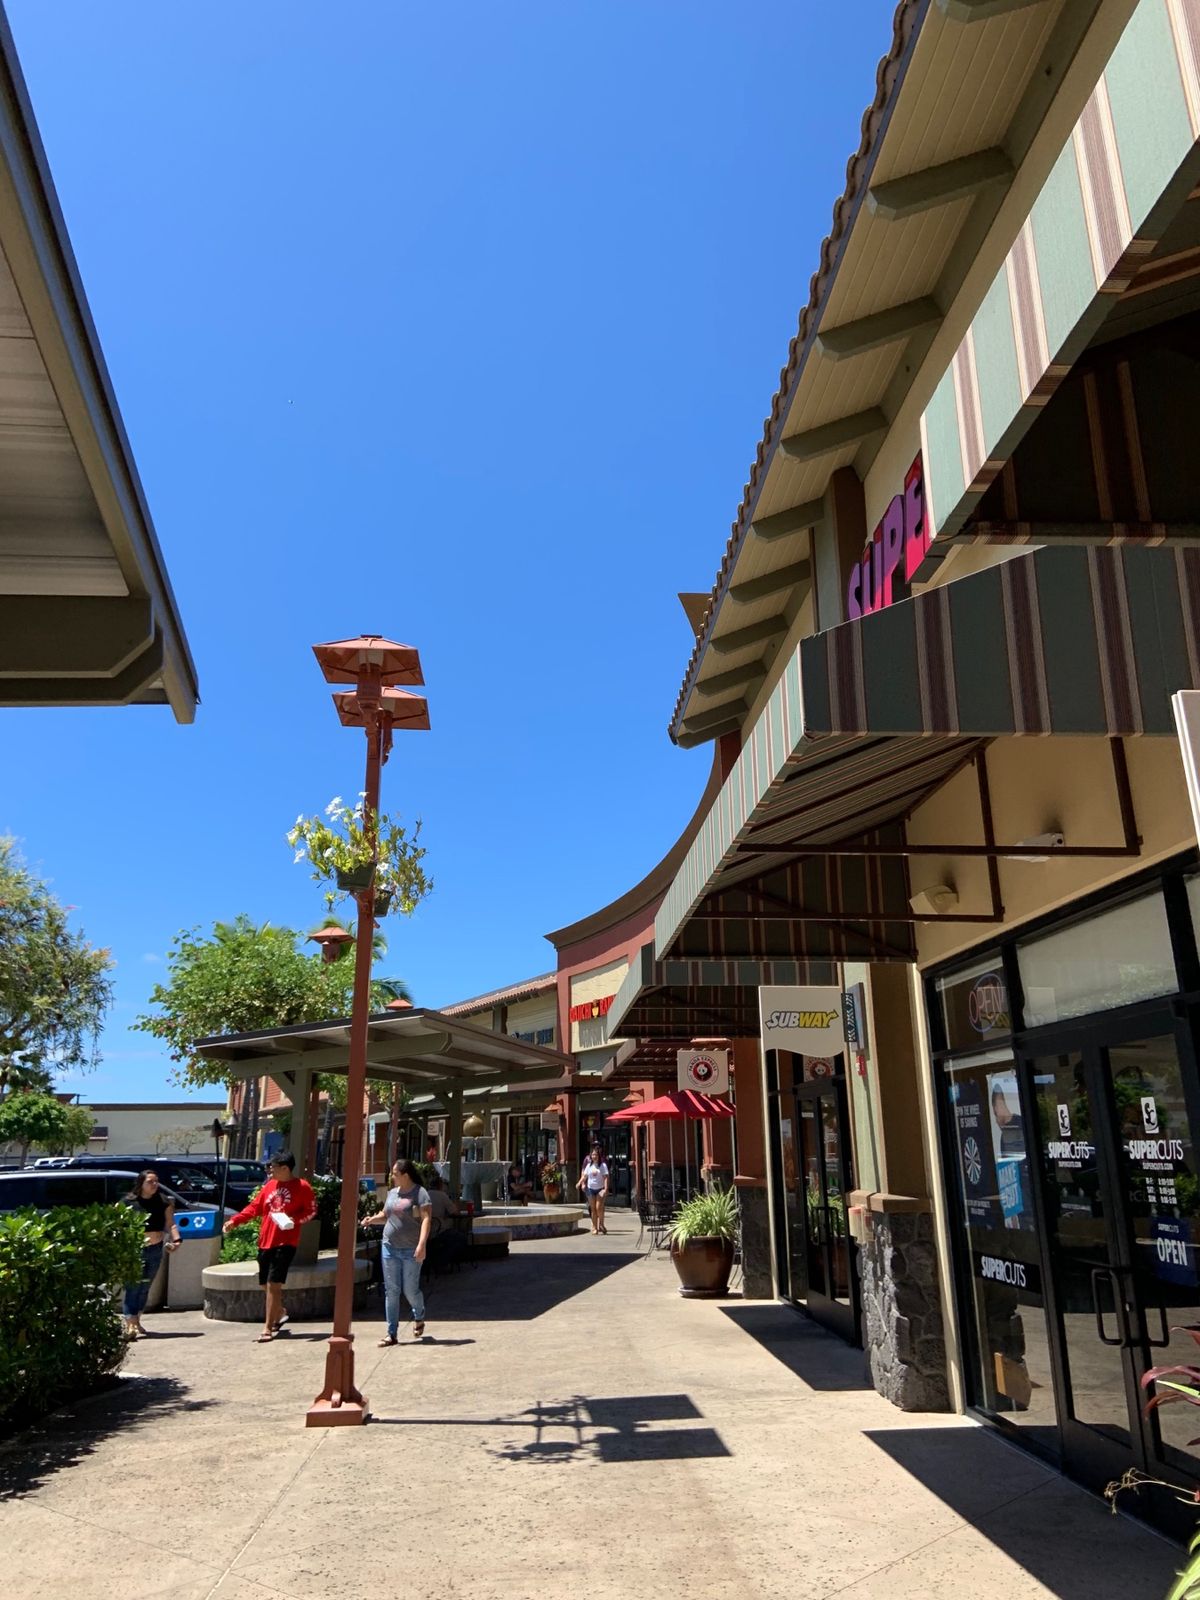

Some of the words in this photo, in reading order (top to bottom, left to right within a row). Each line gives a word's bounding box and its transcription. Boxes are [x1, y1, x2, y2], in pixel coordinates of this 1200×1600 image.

[968, 983, 1002, 1024] OPEN
[765, 1009, 839, 1030] SUBWAY
[1048, 1141, 1089, 1159] SUPERCUTS
[1129, 1139, 1184, 1160] SUPERCUTS
[1157, 1237, 1188, 1266] OPEN
[981, 1255, 1026, 1287] SUPERCUTS
